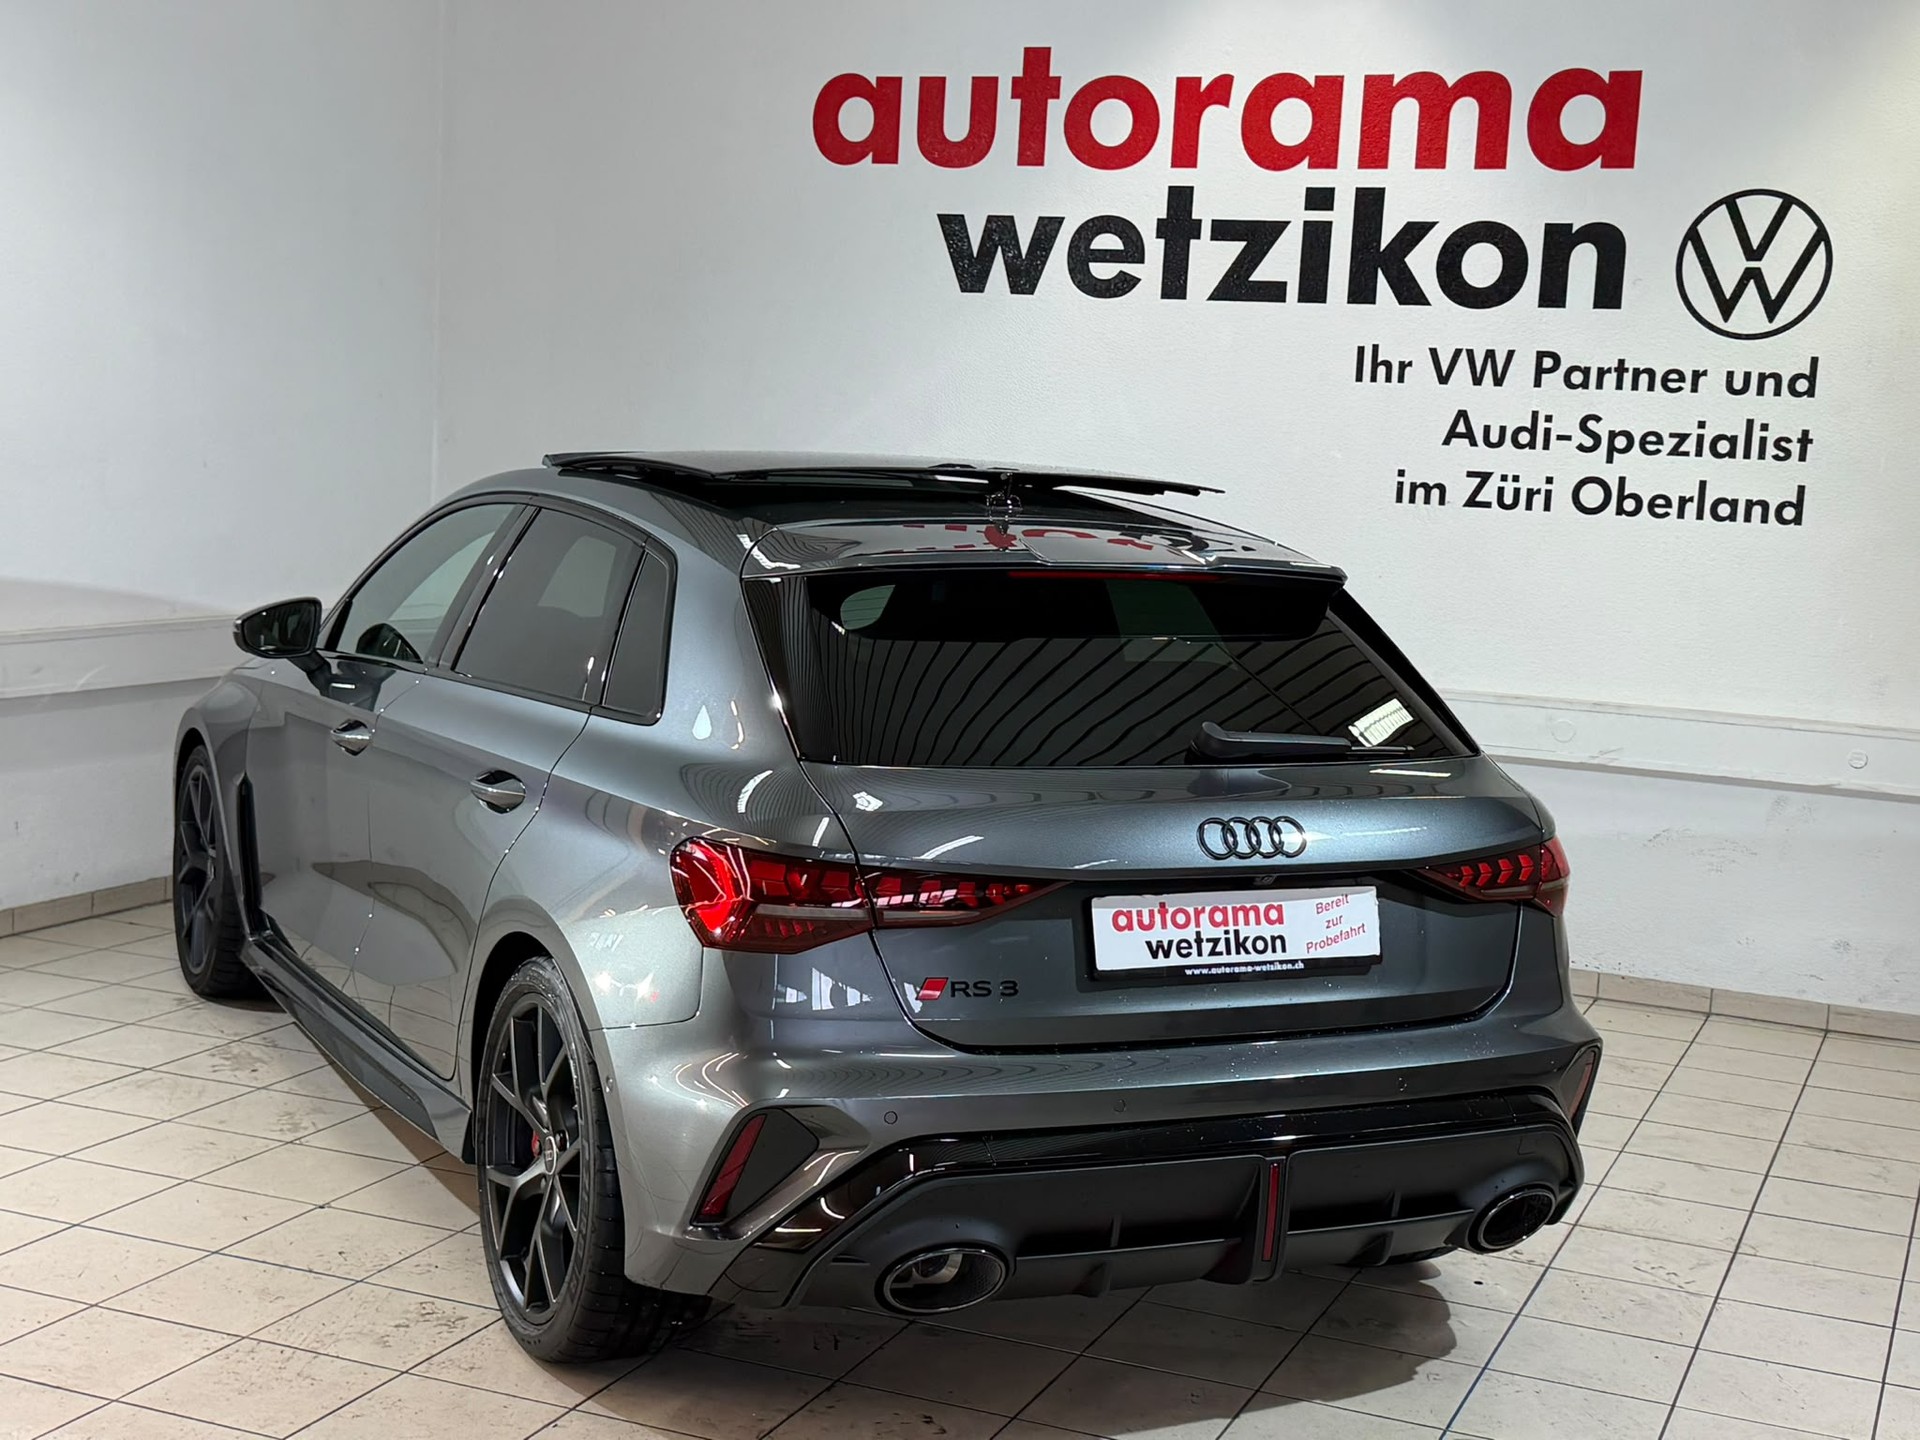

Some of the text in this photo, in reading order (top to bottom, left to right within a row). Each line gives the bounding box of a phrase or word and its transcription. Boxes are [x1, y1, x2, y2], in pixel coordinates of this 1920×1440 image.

[813, 47, 1642, 172] autorama
[937, 186, 1627, 309] wetzikon
[1356, 344, 1819, 398] Ihr VW Partner und
[1442, 409, 1814, 465] Audi-Spezialist
[1396, 468, 1806, 526] im Züri Oberland
[1112, 902, 1285, 933] autorama
[1315, 893, 1349, 915] Bereit
[1325, 914, 1343, 929] zur
[1145, 929, 1287, 960] wetzikon
[1306, 922, 1366, 954] Probefahrt
[951, 980, 1019, 998] RS 3
